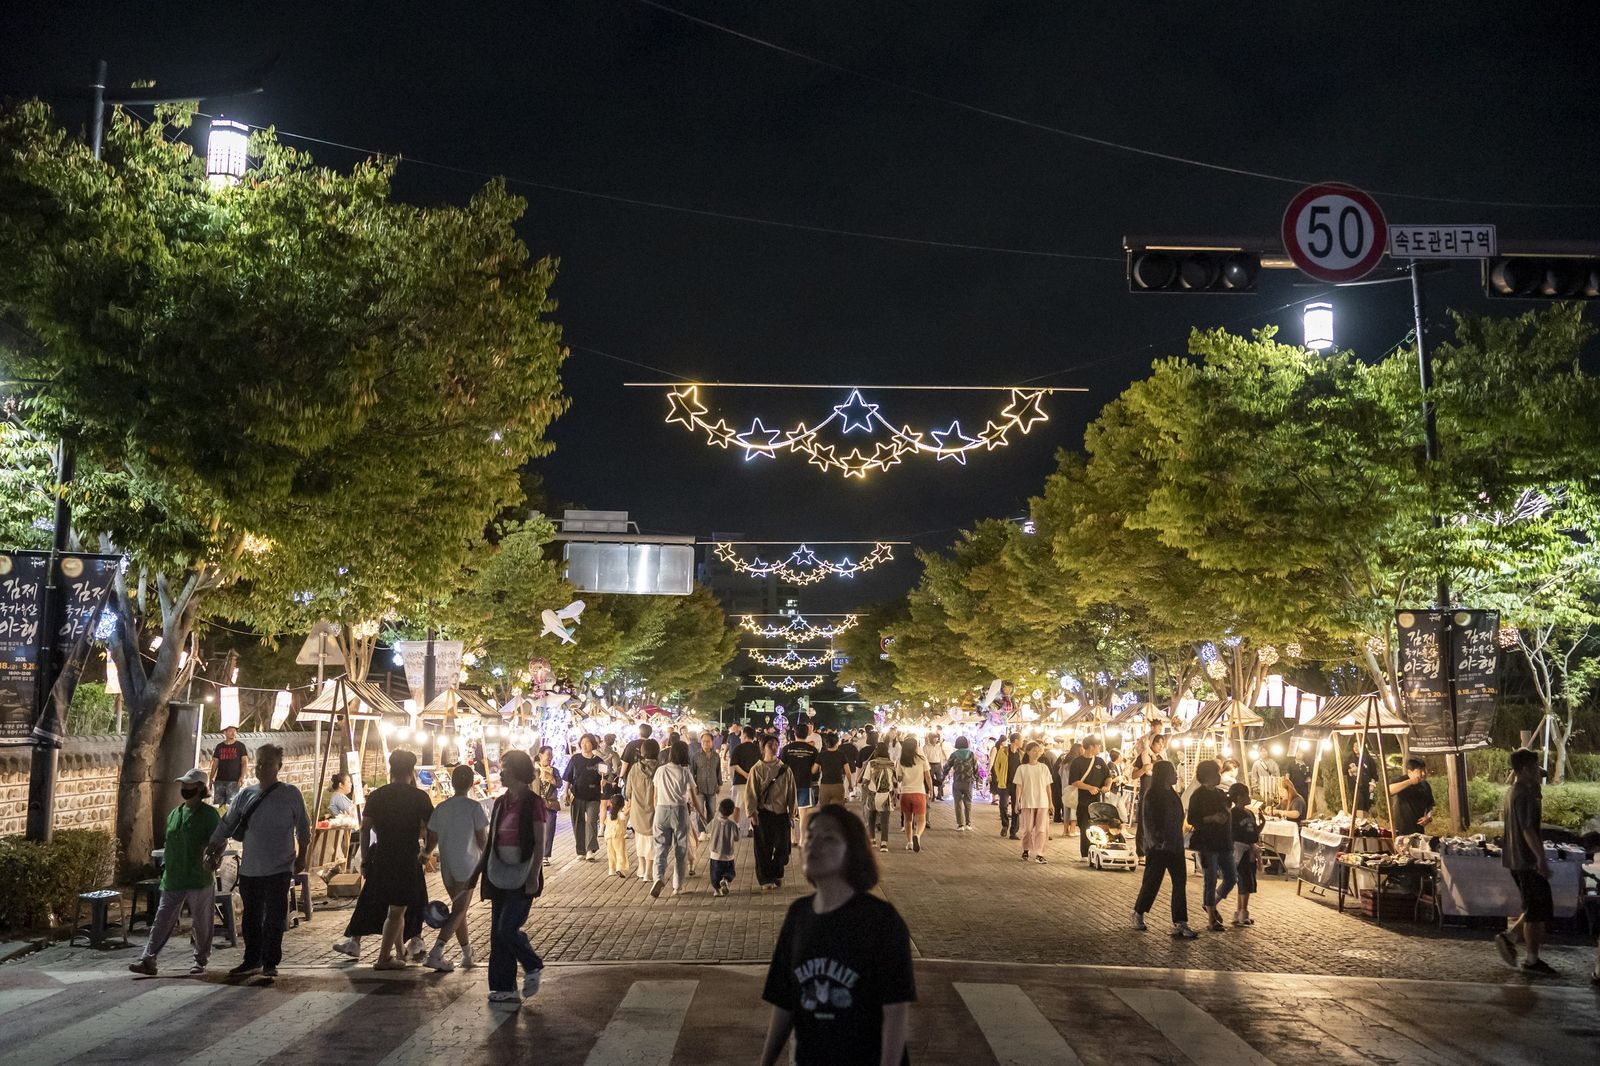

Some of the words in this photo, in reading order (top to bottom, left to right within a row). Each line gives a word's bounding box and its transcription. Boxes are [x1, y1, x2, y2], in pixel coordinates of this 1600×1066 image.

[1308, 205, 1364, 259] 50
[1395, 229, 1490, 253] 속도관리구역
[3, 577, 38, 600] 김제
[1407, 629, 1435, 647] 김제
[1464, 628, 1493, 644] 김제
[1461, 644, 1494, 656] 국가유산
[1404, 657, 1440, 679] 야행
[1459, 655, 1496, 675] 야행
